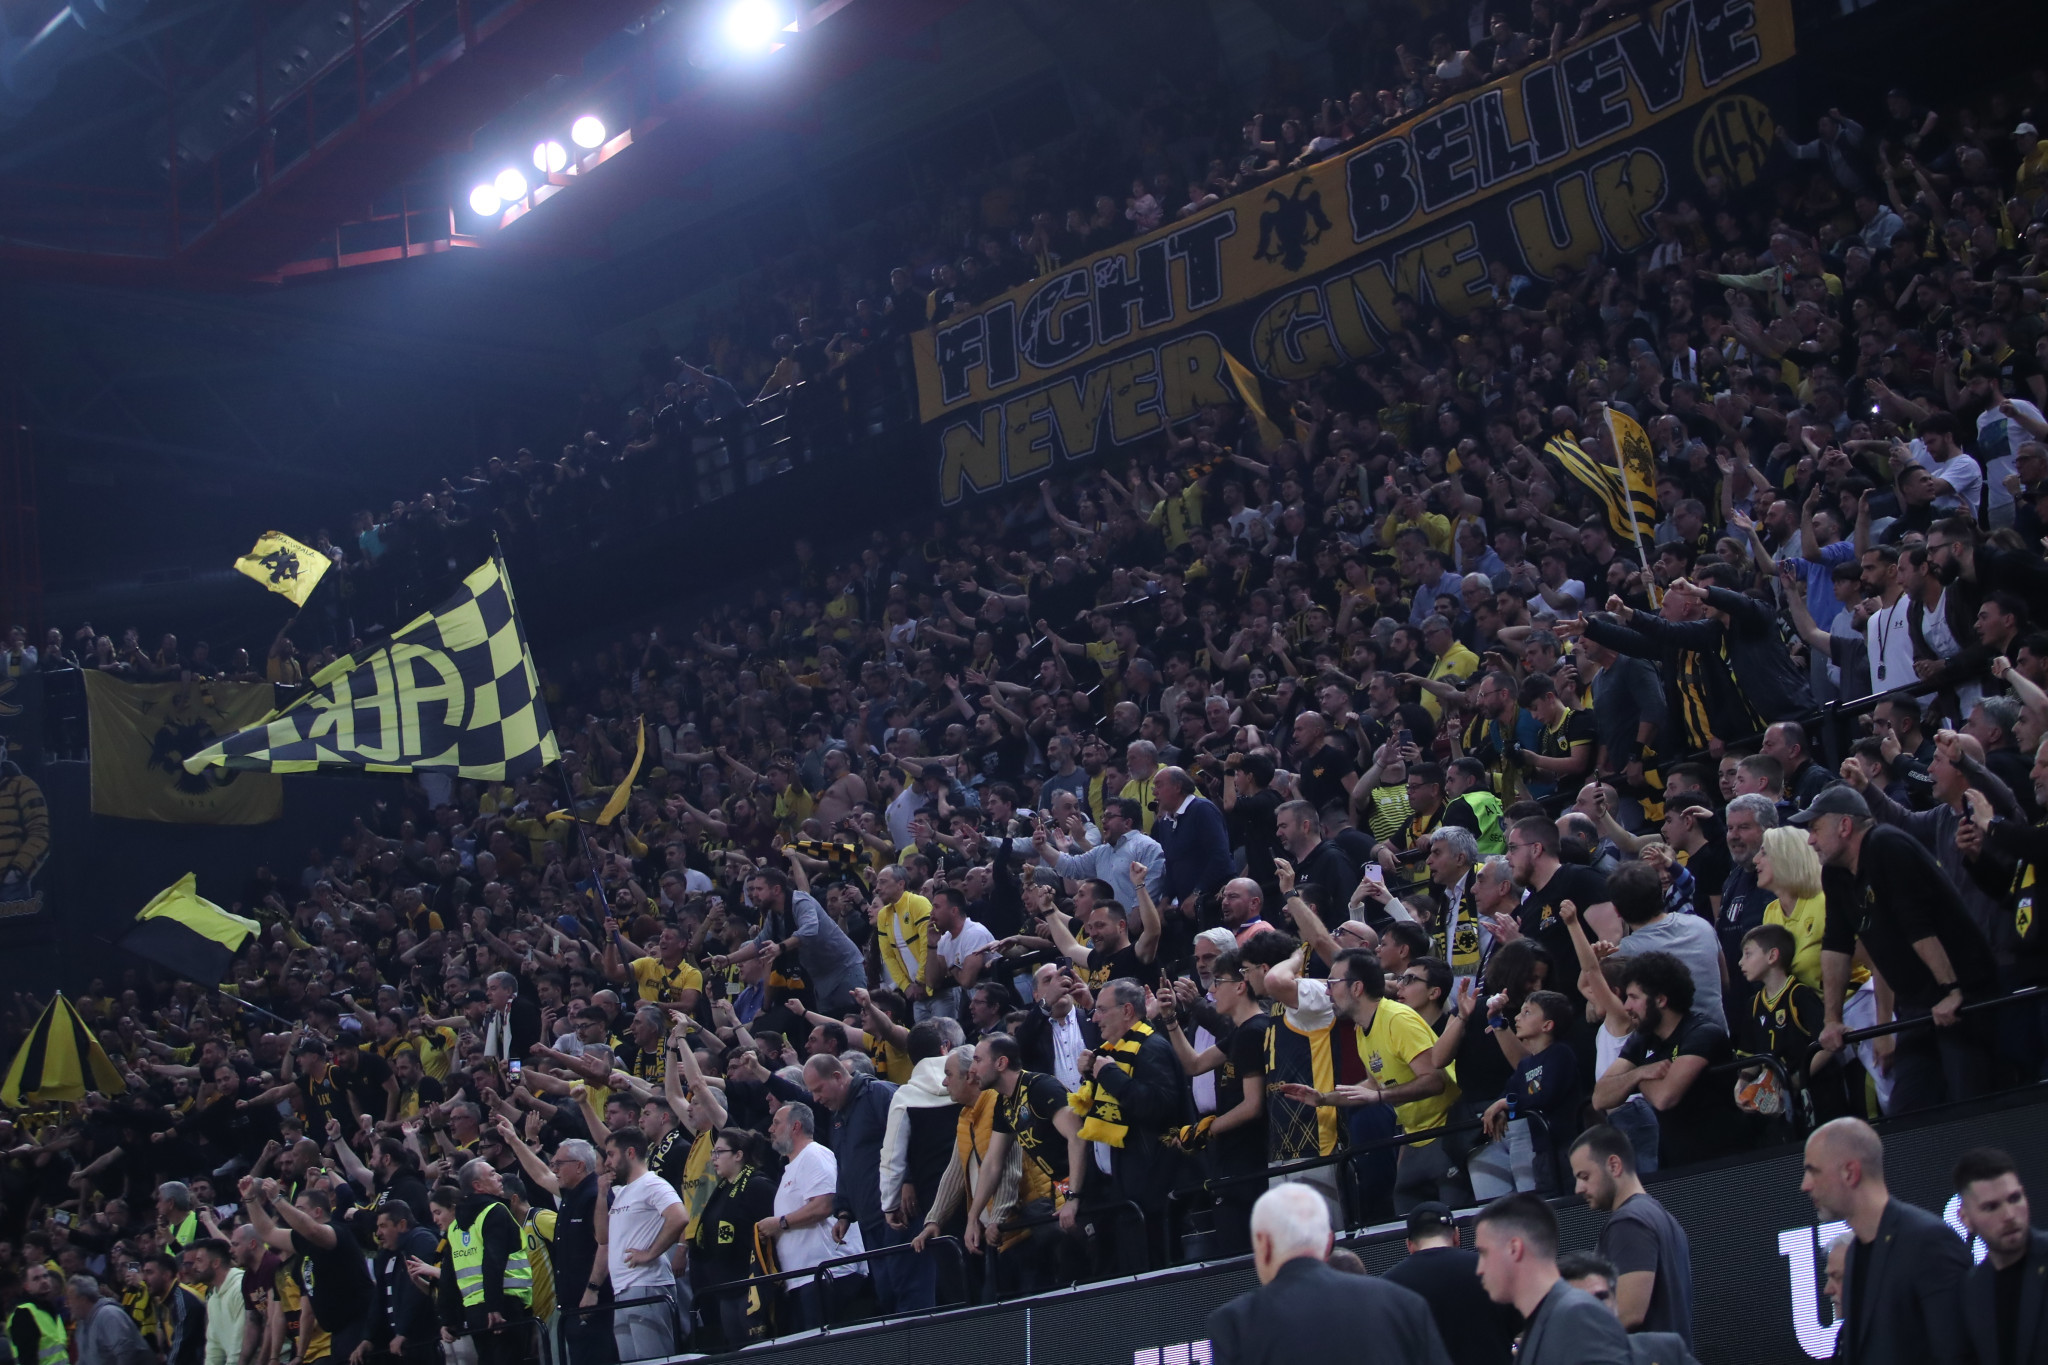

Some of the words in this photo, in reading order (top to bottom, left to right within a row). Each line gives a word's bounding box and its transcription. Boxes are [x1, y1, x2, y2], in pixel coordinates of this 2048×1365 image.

[936, 209, 1236, 404] FIGHT
[1345, 0, 1762, 243] BELIEVE
[939, 331, 1236, 506] NEVER
[1251, 221, 1492, 384] GIVE
[1507, 147, 1668, 282] UP
[453, 1246, 478, 1259] SECURITY
